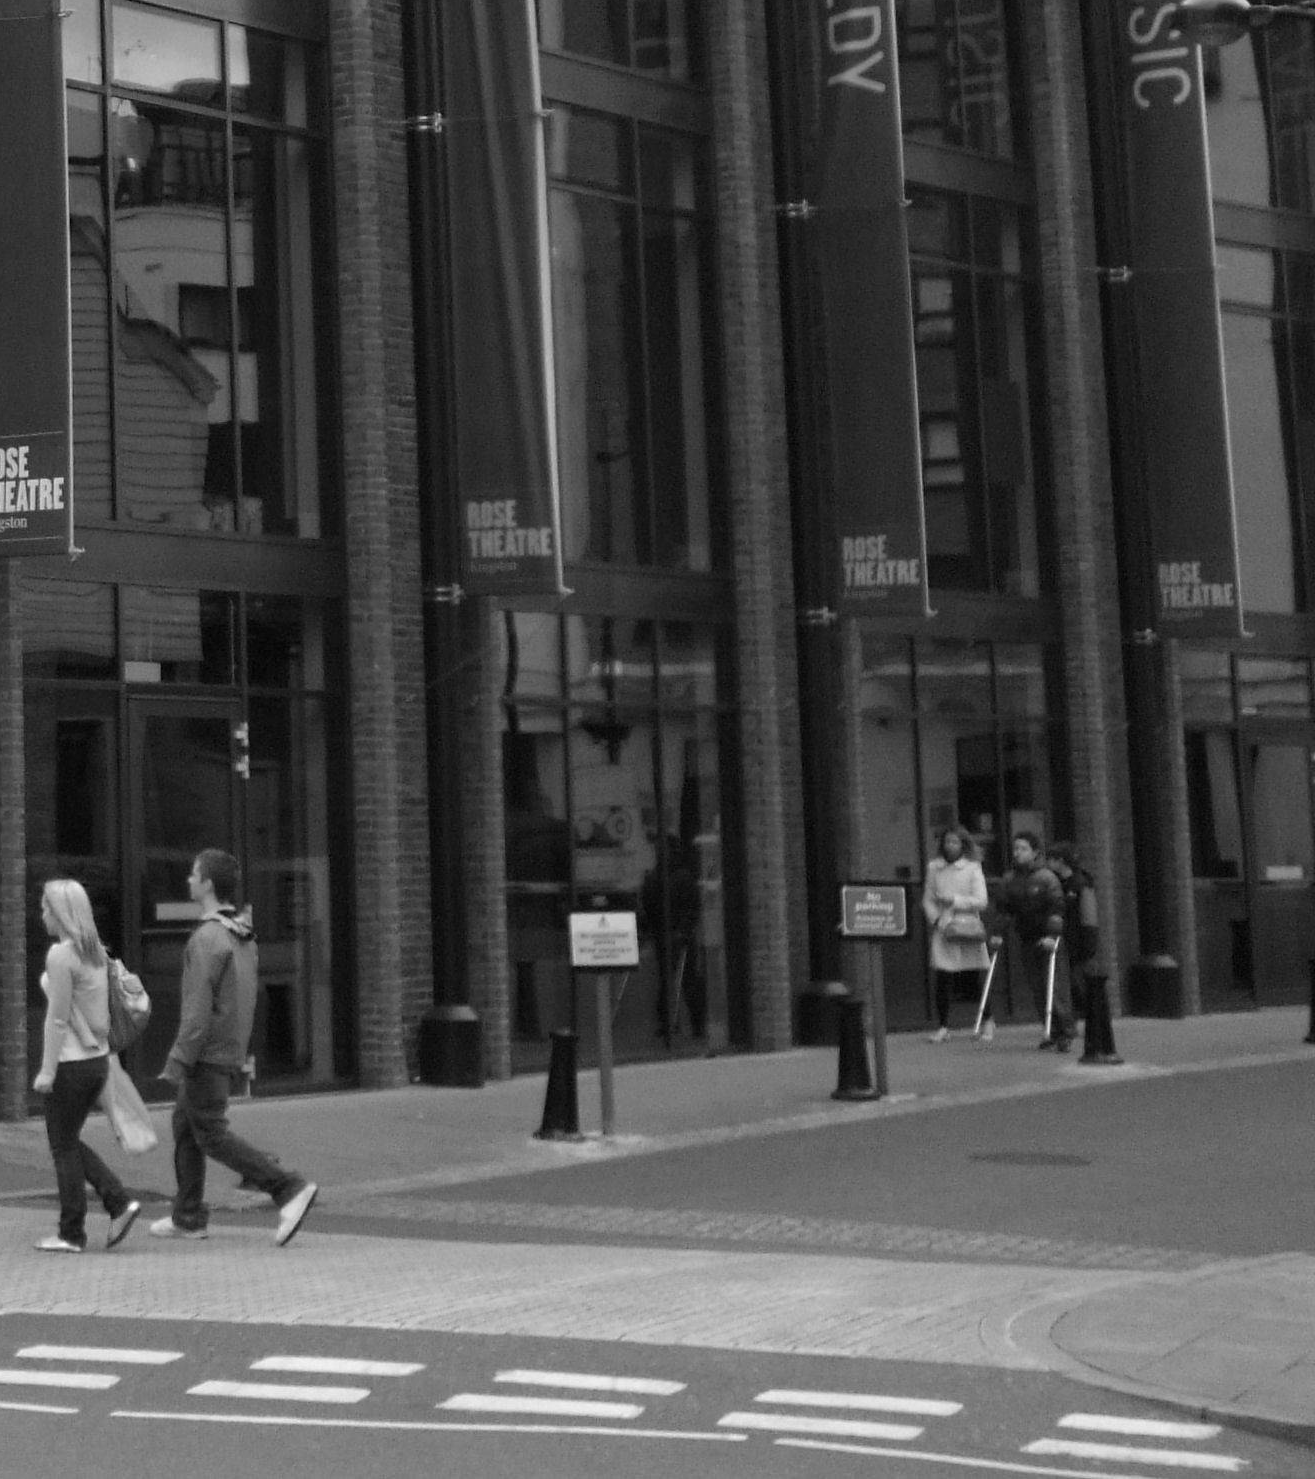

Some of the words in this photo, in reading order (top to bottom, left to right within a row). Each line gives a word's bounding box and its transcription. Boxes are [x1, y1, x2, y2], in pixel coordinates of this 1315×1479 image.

[467, 500, 517, 528] ROSE
[468, 526, 553, 558] THEATRE
[843, 534, 887, 560] ROSE
[843, 558, 920, 587] THEATRE
[1158, 561, 1202, 584] ROSE
[1159, 582, 1234, 607] THEATRE
